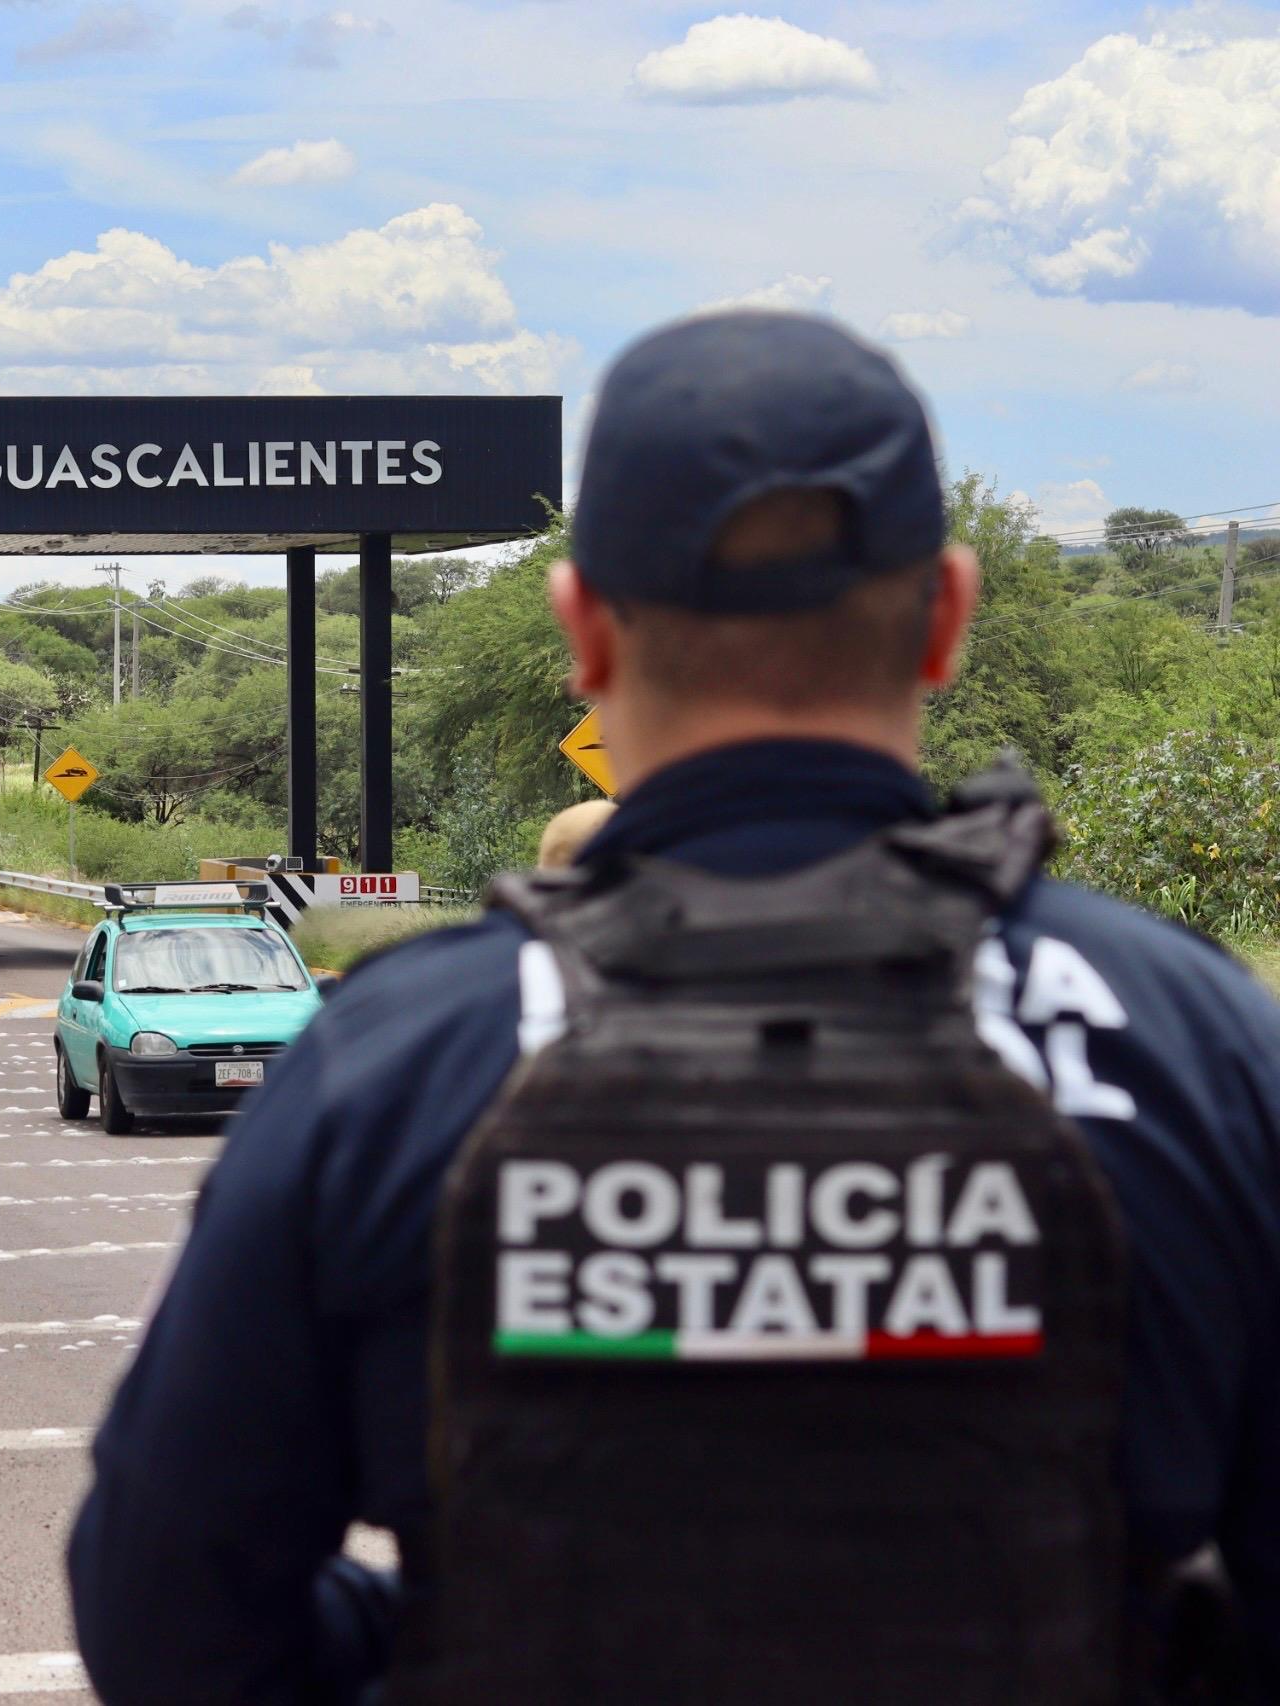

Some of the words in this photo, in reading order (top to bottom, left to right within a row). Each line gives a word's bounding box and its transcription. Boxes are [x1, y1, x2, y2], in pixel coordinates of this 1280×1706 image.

[343, 878, 391, 893] 911
[498, 1153, 1040, 1248] POLICÍA
[498, 1250, 1041, 1337] ESTATAL
